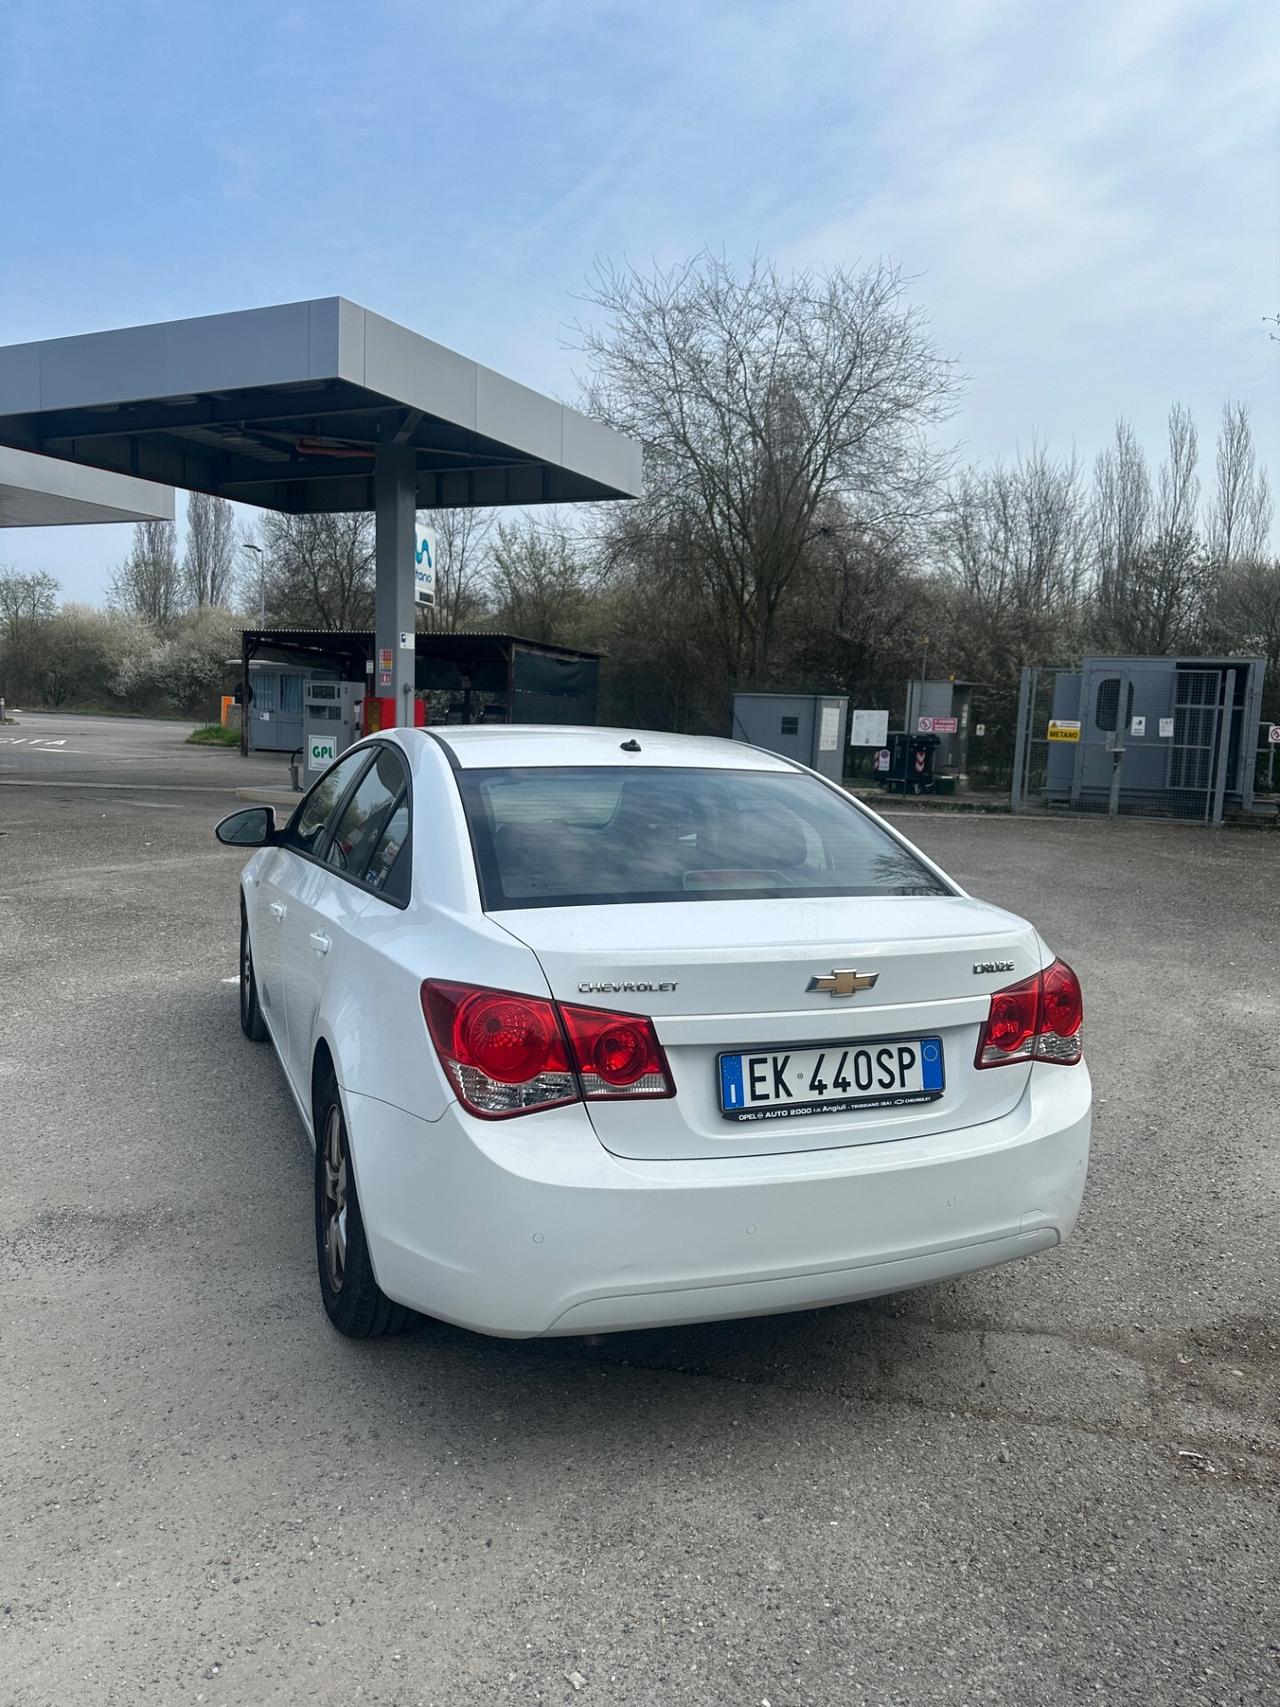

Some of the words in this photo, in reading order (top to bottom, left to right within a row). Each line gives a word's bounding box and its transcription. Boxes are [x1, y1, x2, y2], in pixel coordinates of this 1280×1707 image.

[1049, 730, 1078, 739] METANO
[312, 746, 333, 759] GPL
[973, 960, 1015, 974] CRUZE
[578, 981, 679, 993] CHEVROLET
[749, 1055, 793, 1102] EK
[809, 1046, 916, 1095] 440SP
[765, 1110, 788, 1118] AUTO
[790, 1108, 812, 1116] 2000
[822, 1103, 847, 1112] Angiuli
